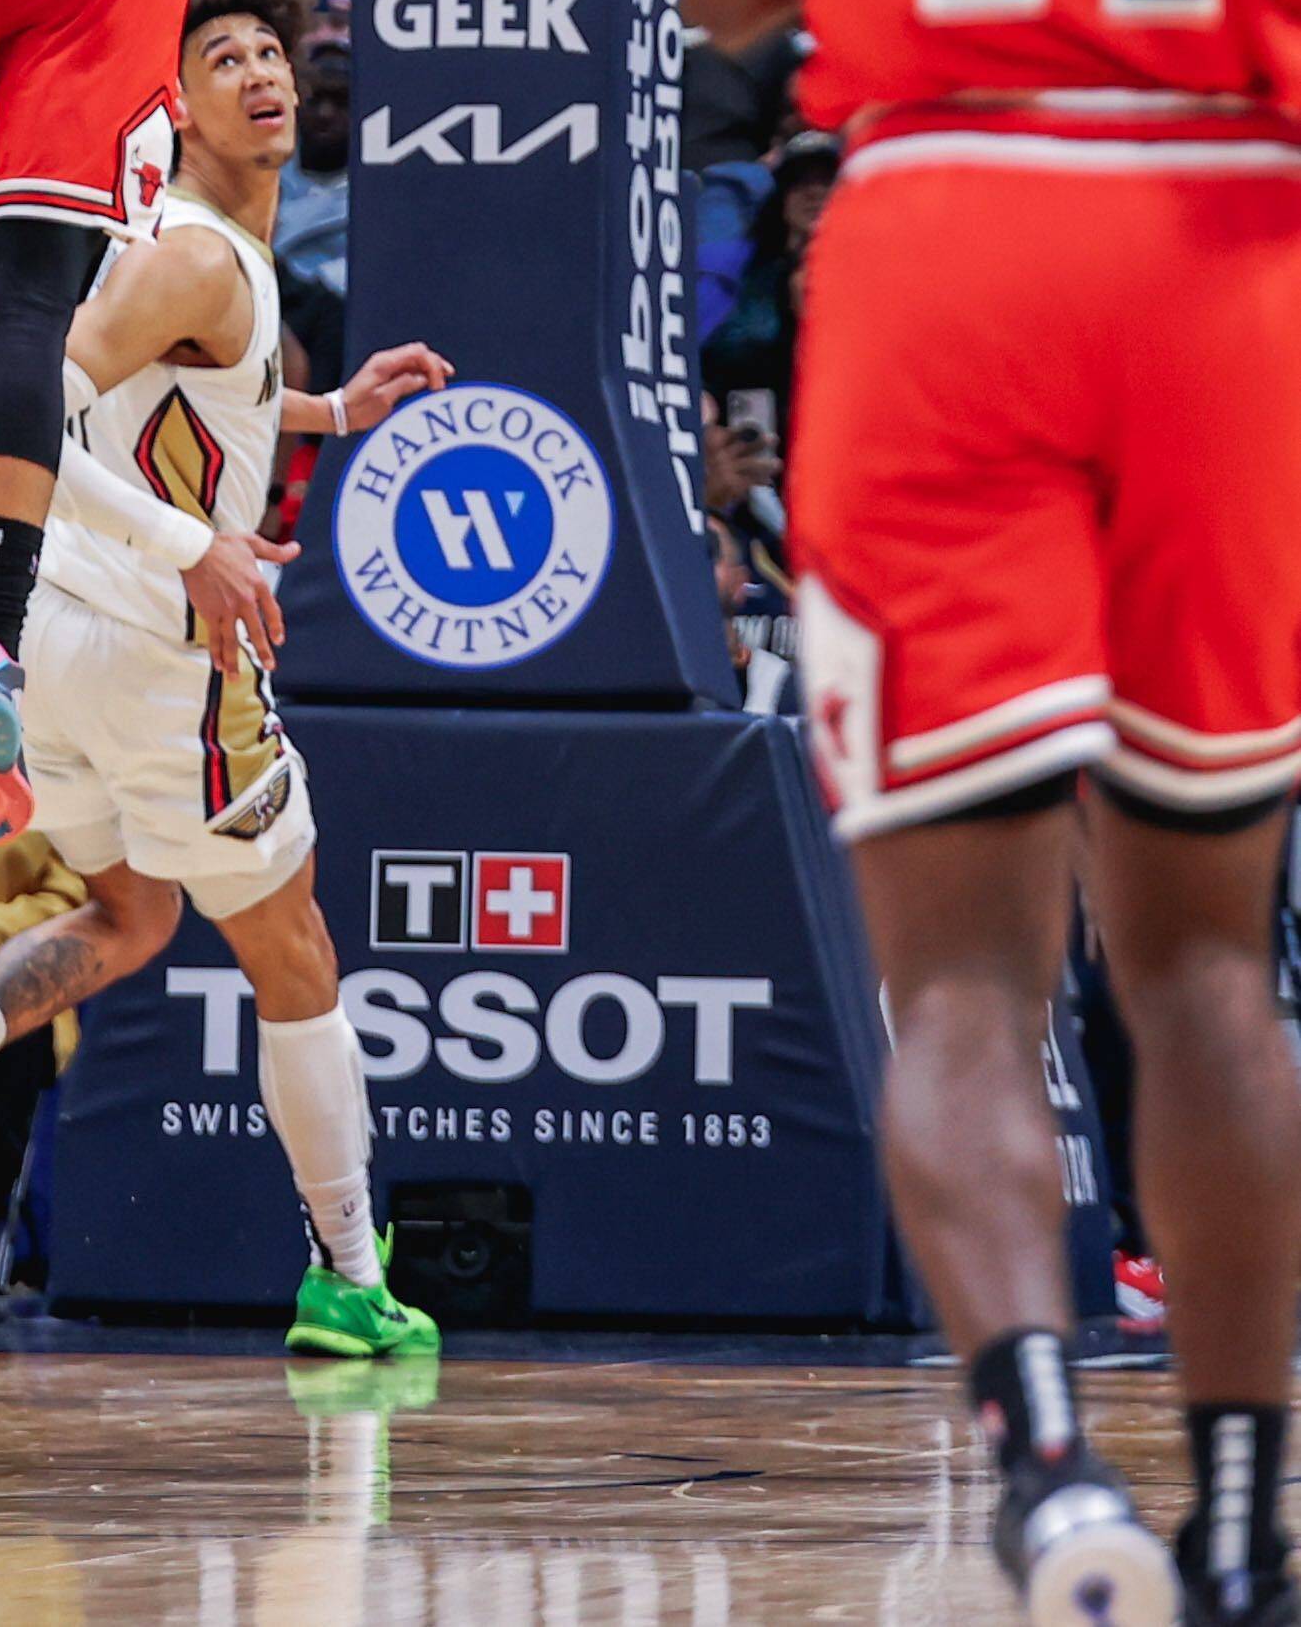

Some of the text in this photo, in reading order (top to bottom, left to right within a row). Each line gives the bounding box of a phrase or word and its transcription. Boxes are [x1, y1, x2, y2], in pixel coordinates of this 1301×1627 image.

[361, 103, 600, 165] KIA
[354, 398, 594, 505] HANCOCK
[354, 547, 588, 653] WHITNEY
[165, 967, 773, 1085] TSSOT
[161, 1101, 772, 1149] SWIS TCHES SINCE 1853
